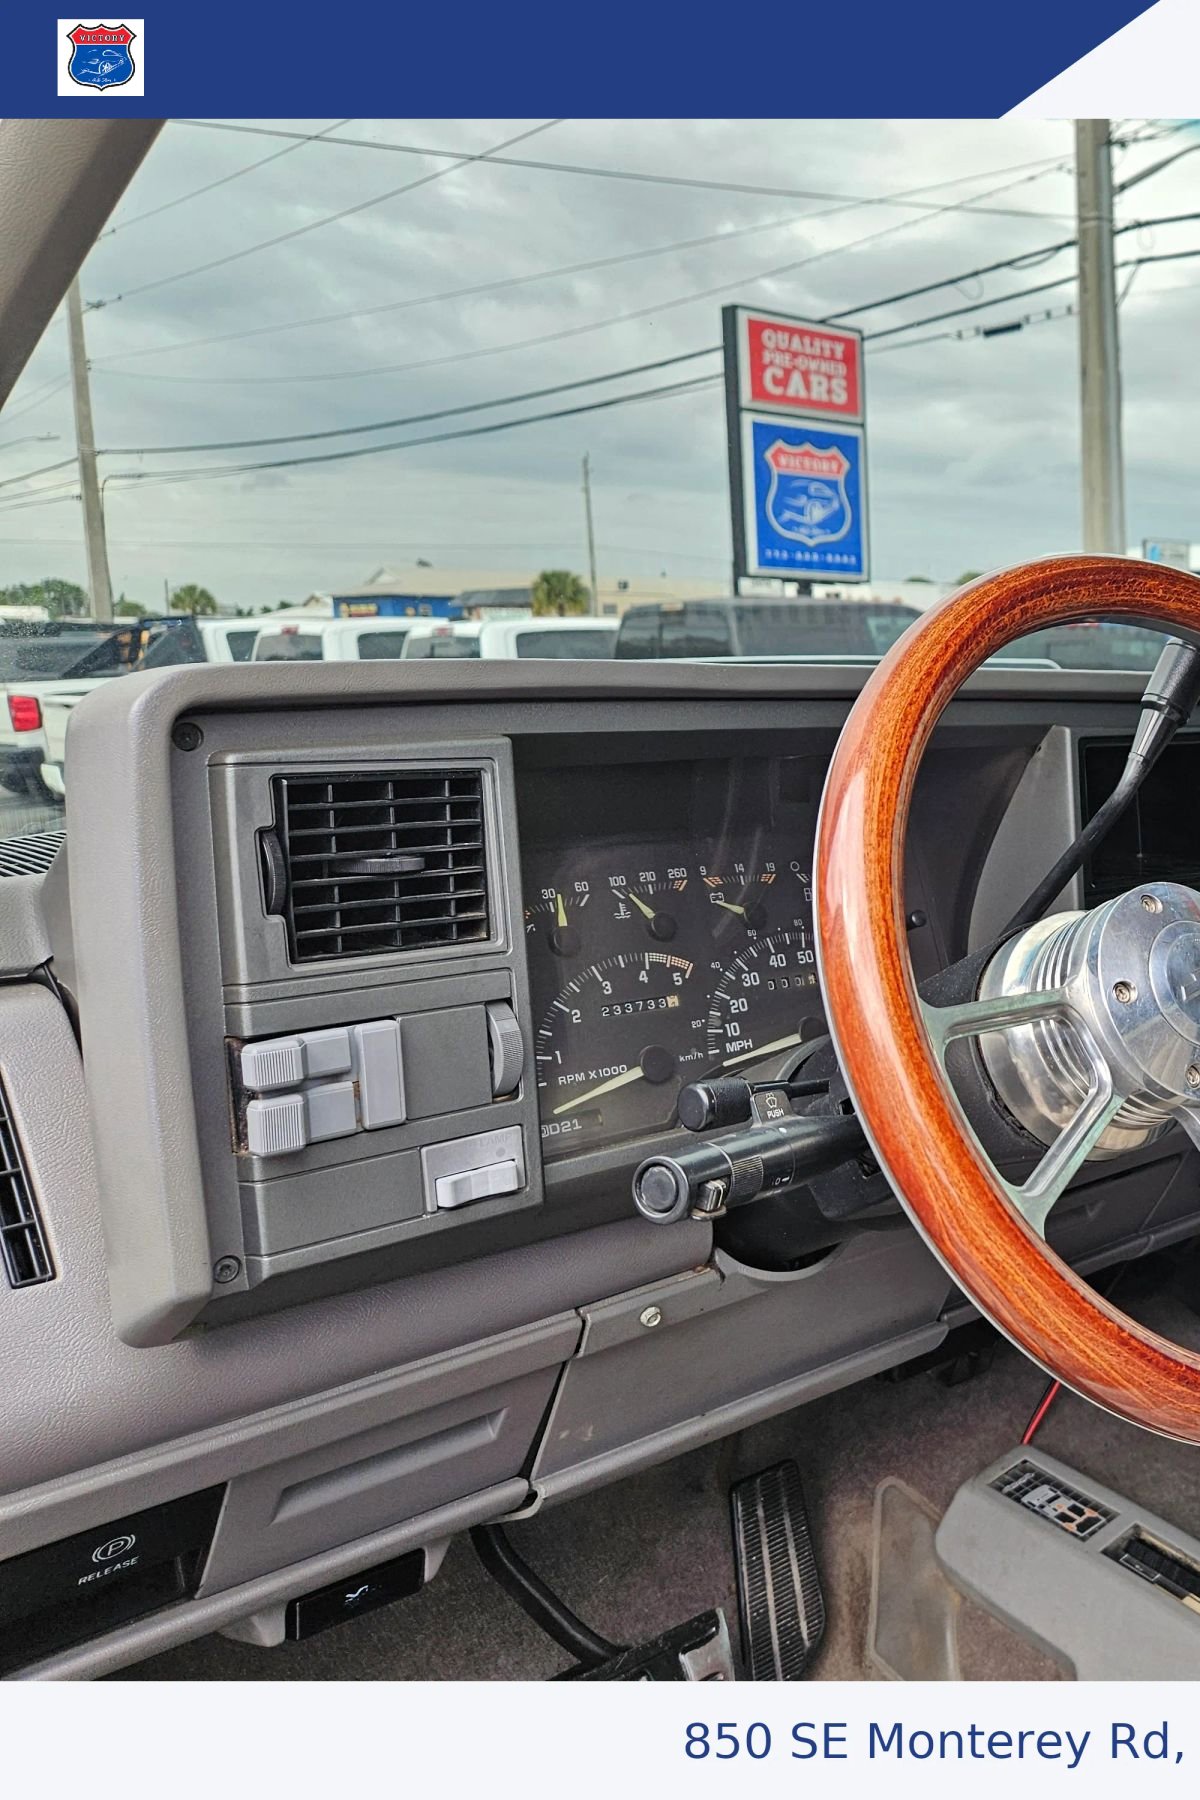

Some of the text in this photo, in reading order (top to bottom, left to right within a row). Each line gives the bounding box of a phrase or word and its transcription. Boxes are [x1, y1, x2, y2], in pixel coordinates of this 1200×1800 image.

[761, 328, 845, 360] QUALITY
[762, 349, 847, 376] PRE-OWNED
[763, 366, 848, 405] CARS
[667, 867, 687, 879] 260
[700, 866, 706, 876] 9
[734, 863, 744, 873] 14
[765, 862, 775, 872] 19
[608, 875, 626, 887] 100
[639, 871, 656, 882] 210
[574, 881, 589, 892] 60
[541, 888, 556, 899] 30
[769, 953, 786, 967] 40
[797, 950, 814, 964] 50
[710, 961, 720, 969] 40
[639, 970, 648, 983] 4
[672, 972, 682, 985] 5
[741, 972, 760, 987] 30
[601, 981, 612, 995] 3
[729, 998, 748, 1013] 20
[571, 1009, 581, 1023] 2
[724, 1022, 740, 1037] 10
[725, 1039, 753, 1053] MPH
[555, 1051, 562, 1064] 1
[679, 1051, 704, 1062] km/h
[558, 1072, 586, 1086] RPM
[766, 1107, 784, 1120] PUSH
[77, 1555, 140, 1586] RELEASE
